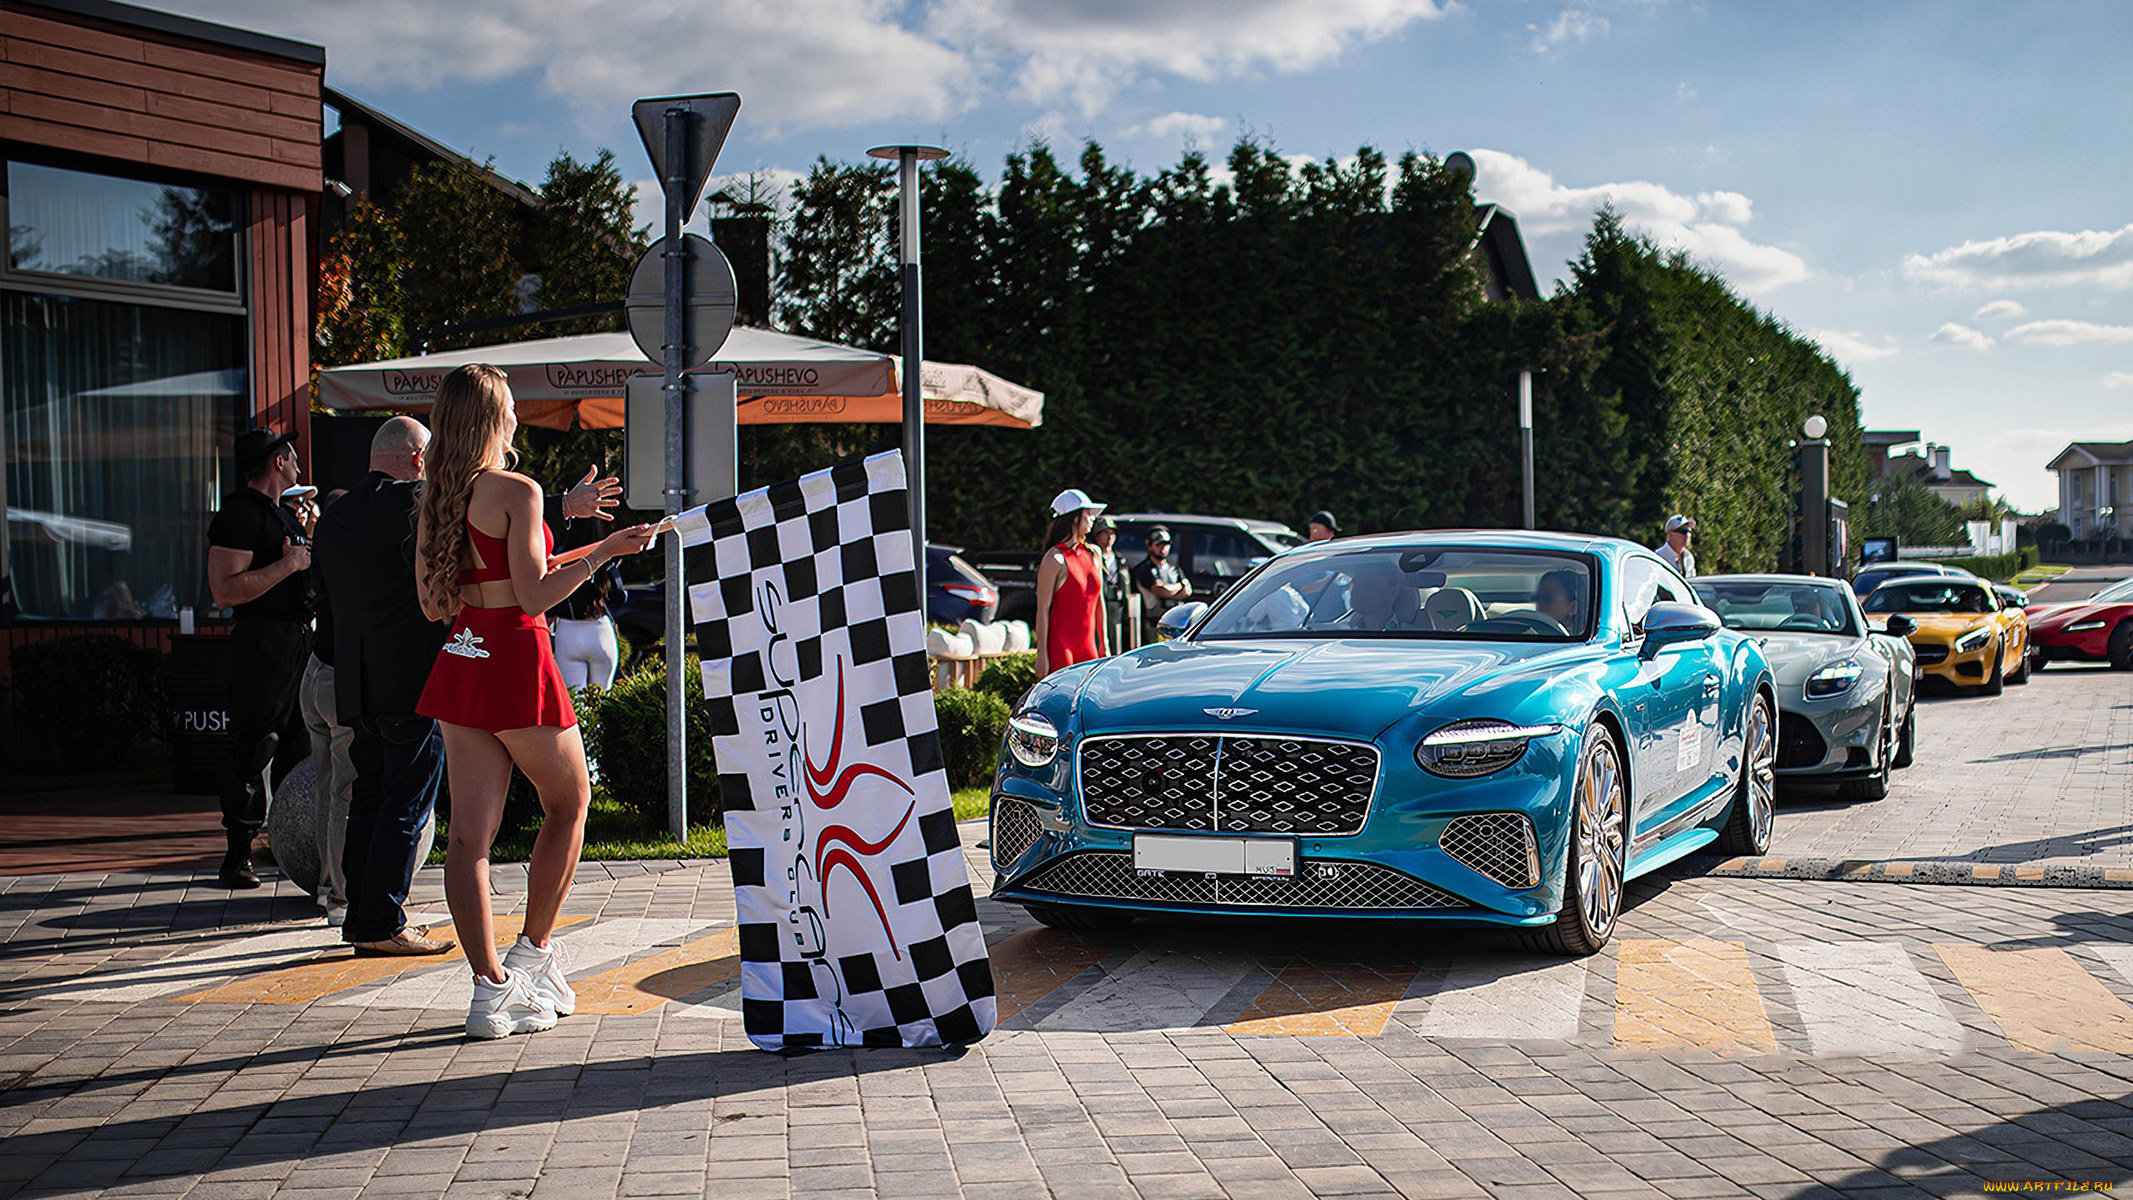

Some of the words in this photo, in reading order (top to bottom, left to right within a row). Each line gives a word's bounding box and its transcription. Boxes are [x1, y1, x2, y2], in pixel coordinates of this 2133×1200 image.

[392, 374, 442, 391] PAPUS
[557, 368, 645, 386] PAPUSHEV
[727, 367, 818, 385] APUSHEVO
